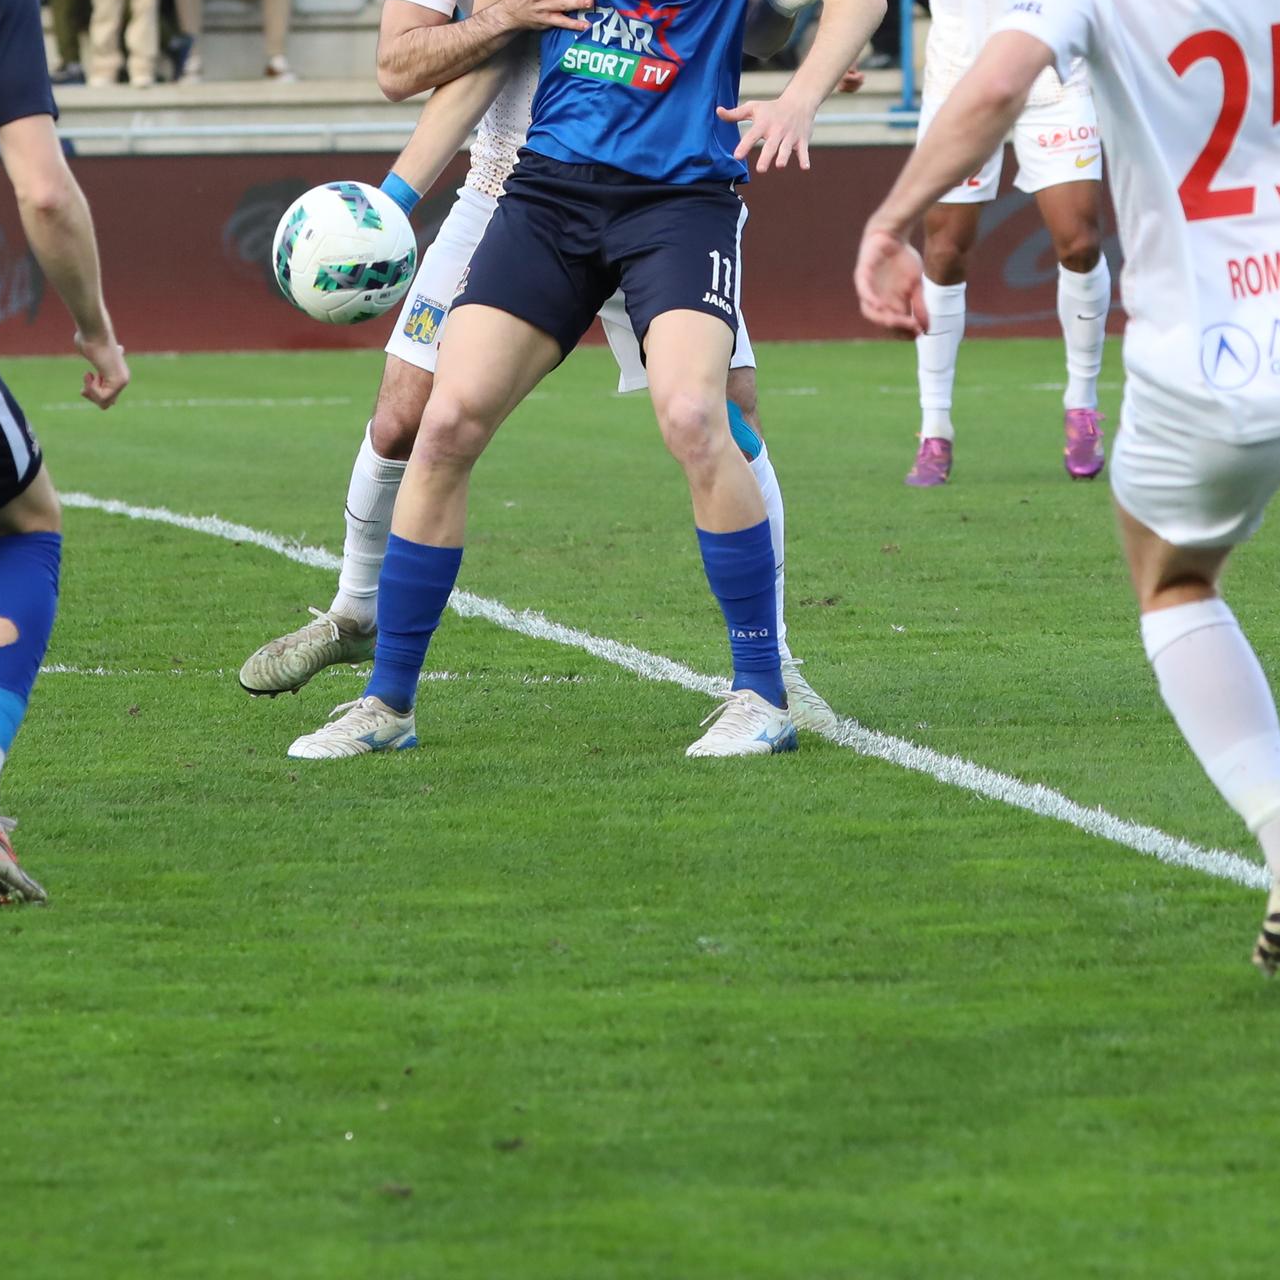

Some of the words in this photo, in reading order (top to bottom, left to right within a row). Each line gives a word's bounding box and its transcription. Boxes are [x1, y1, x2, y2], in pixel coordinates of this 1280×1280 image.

[562, 48, 635, 78] SPORT
[642, 65, 671, 85] TV
[709, 250, 732, 298] 11
[702, 291, 732, 315] JAKO
